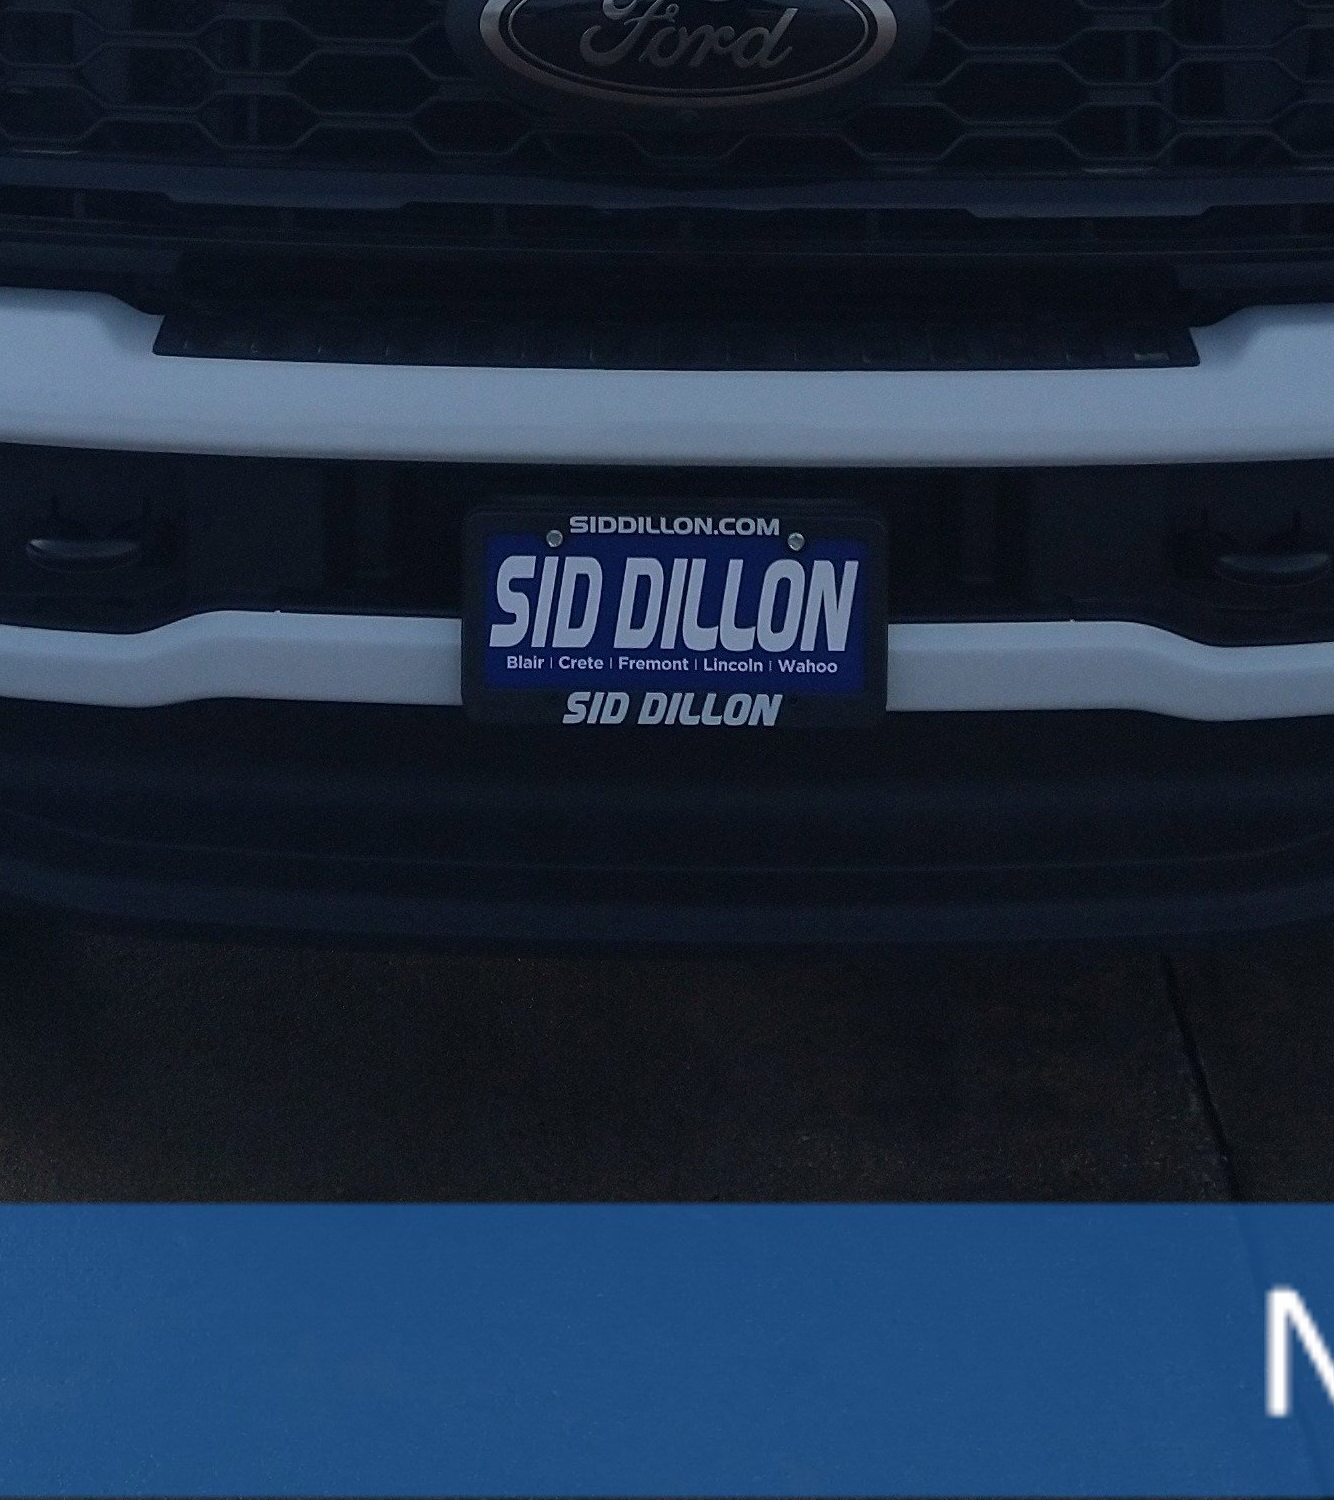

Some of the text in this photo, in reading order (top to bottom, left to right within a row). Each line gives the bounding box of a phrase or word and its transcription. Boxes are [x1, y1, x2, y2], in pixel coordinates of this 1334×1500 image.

[569, 515, 781, 536] SIDDILLON.COM
[489, 555, 859, 653] SID DILLON
[506, 654, 838, 674] Blair Crete Fremont Lincoln Wahoo
[562, 691, 784, 727] SID DILLON
